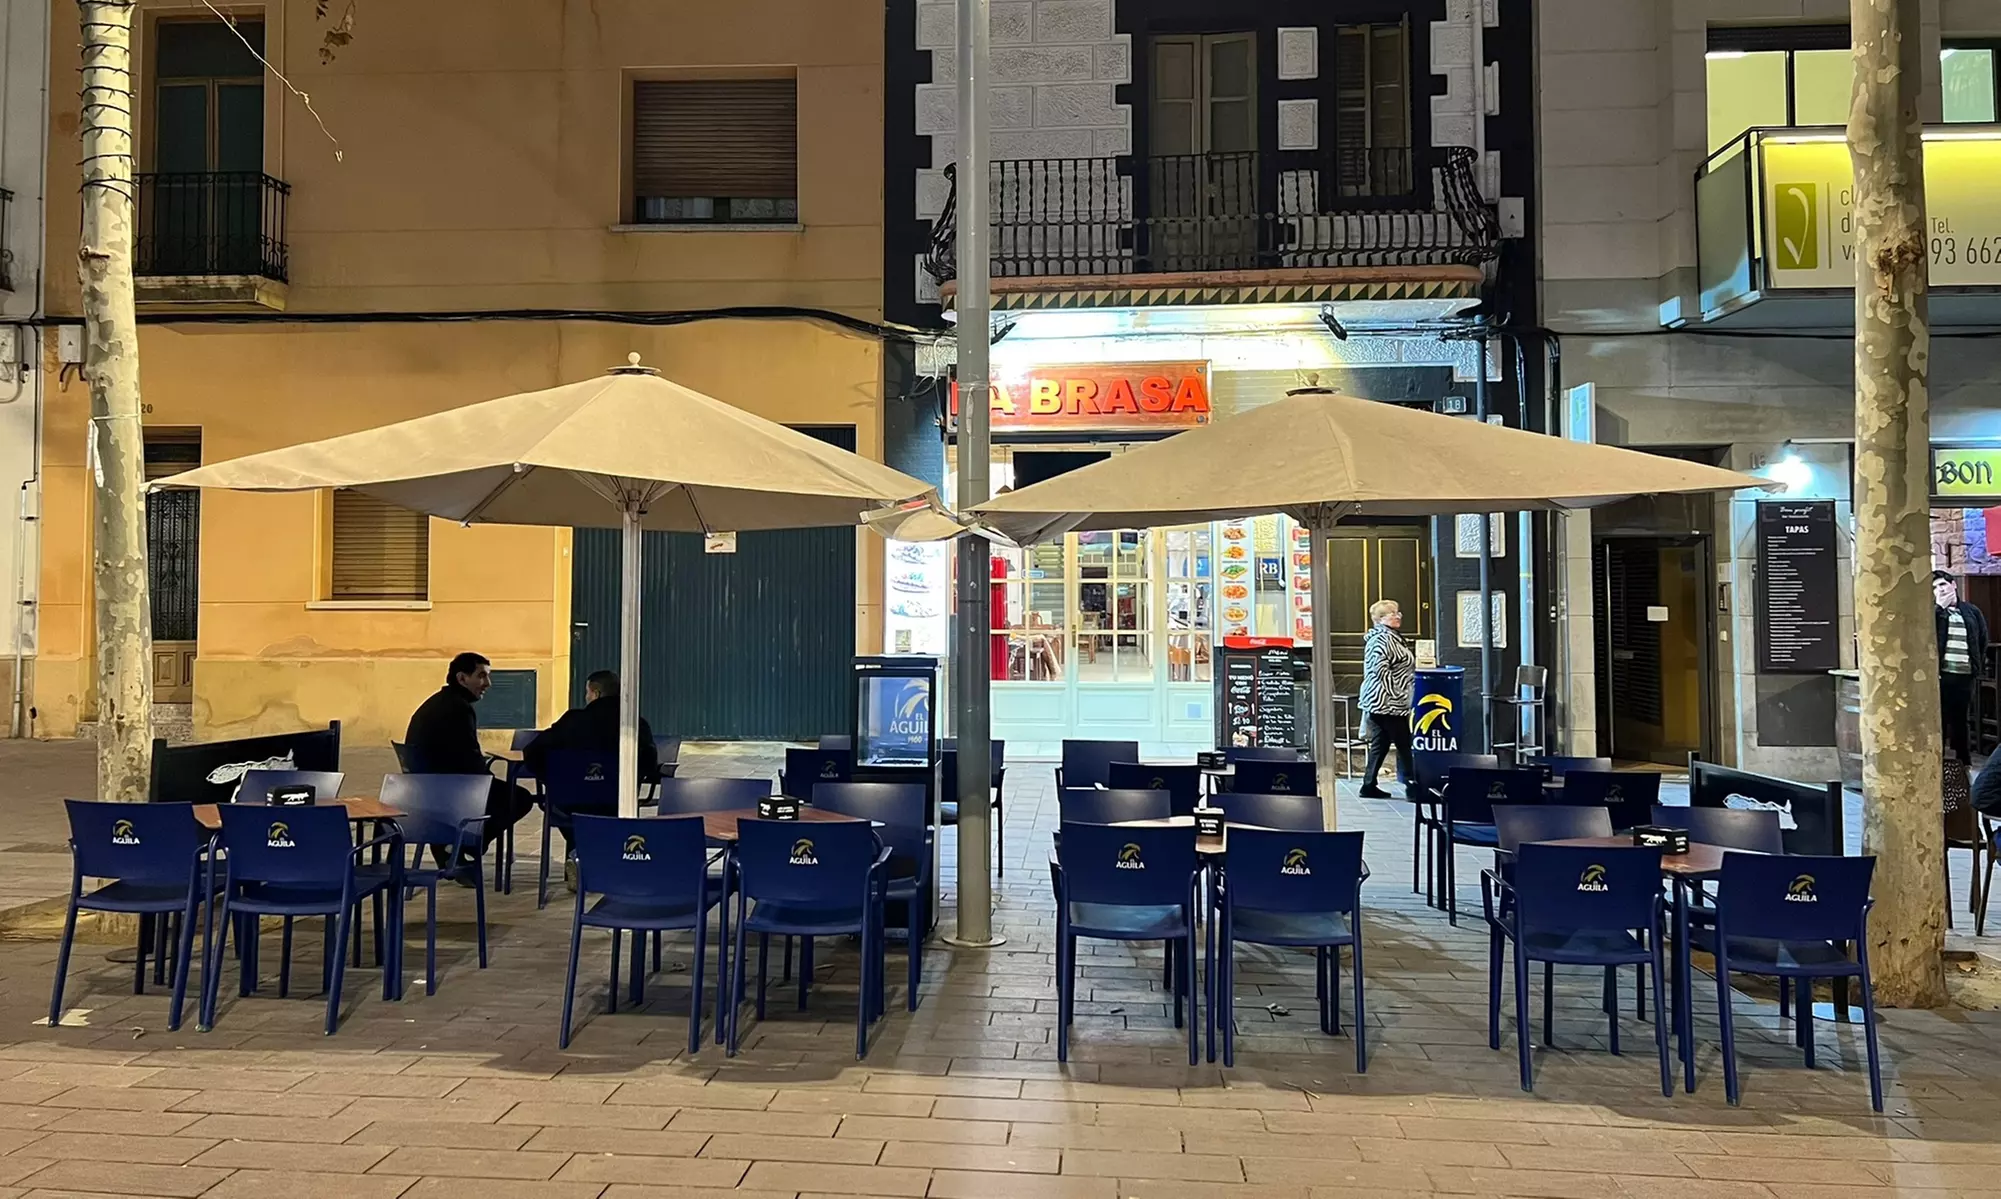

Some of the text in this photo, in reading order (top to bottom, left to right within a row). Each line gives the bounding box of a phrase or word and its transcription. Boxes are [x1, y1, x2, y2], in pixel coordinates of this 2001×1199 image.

[1931, 217, 1954, 234] Tel.
[1931, 236, 2001, 265] 93 662
[951, 376, 1209, 415] A BRASA
[141, 403, 153, 414] 20
[1448, 399, 1462, 411] 18
[1785, 525, 1809, 533] TAPAS
[915, 712, 923, 721] EL
[889, 720, 928, 735] AGUIL
[1431, 729, 1442, 738] EL
[1411, 737, 1458, 751] GUILA
[112, 836, 141, 845] AGUILA
[267, 839, 296, 847] AGUILA
[622, 852, 651, 861] AGUILA
[789, 856, 819, 865] AGUILA
[1116, 861, 1145, 869] AGUILA
[1280, 867, 1311, 875] AGUILA
[1577, 882, 1608, 892] AGUILA
[1785, 893, 1817, 902] AGUILA
